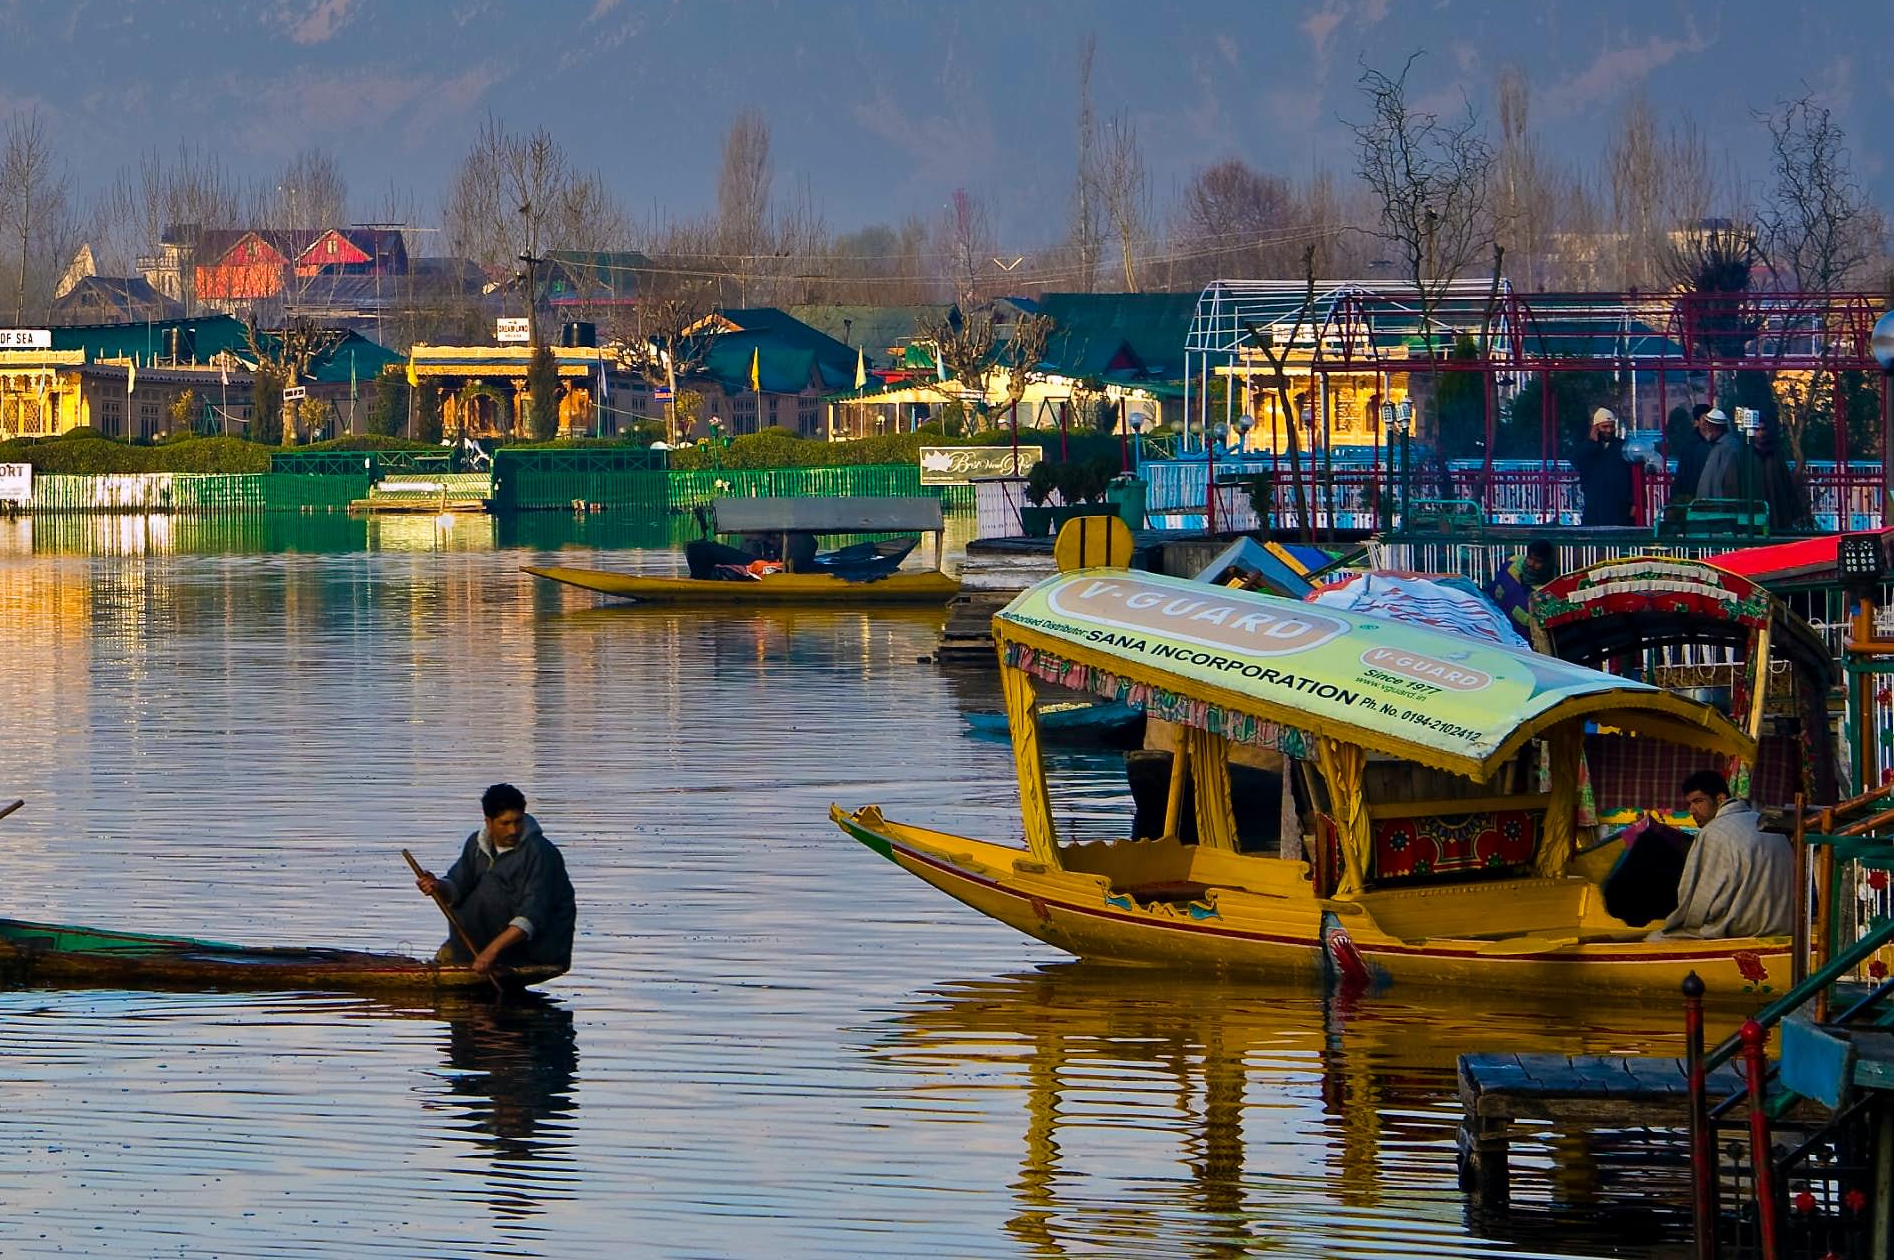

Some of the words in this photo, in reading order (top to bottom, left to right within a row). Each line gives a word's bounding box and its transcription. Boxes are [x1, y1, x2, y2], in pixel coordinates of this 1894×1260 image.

[16, 333, 33, 344] SEA
[1086, 630, 1147, 652] SANA
[1151, 643, 1360, 705] INCORPORATION
[1359, 697, 1377, 711] Ph.
[1379, 703, 1397, 718] No.
[1401, 710, 1482, 741] 0194-2102412
[1364, 669, 1403, 685] Since
[1406, 681, 1443, 695] 1977
